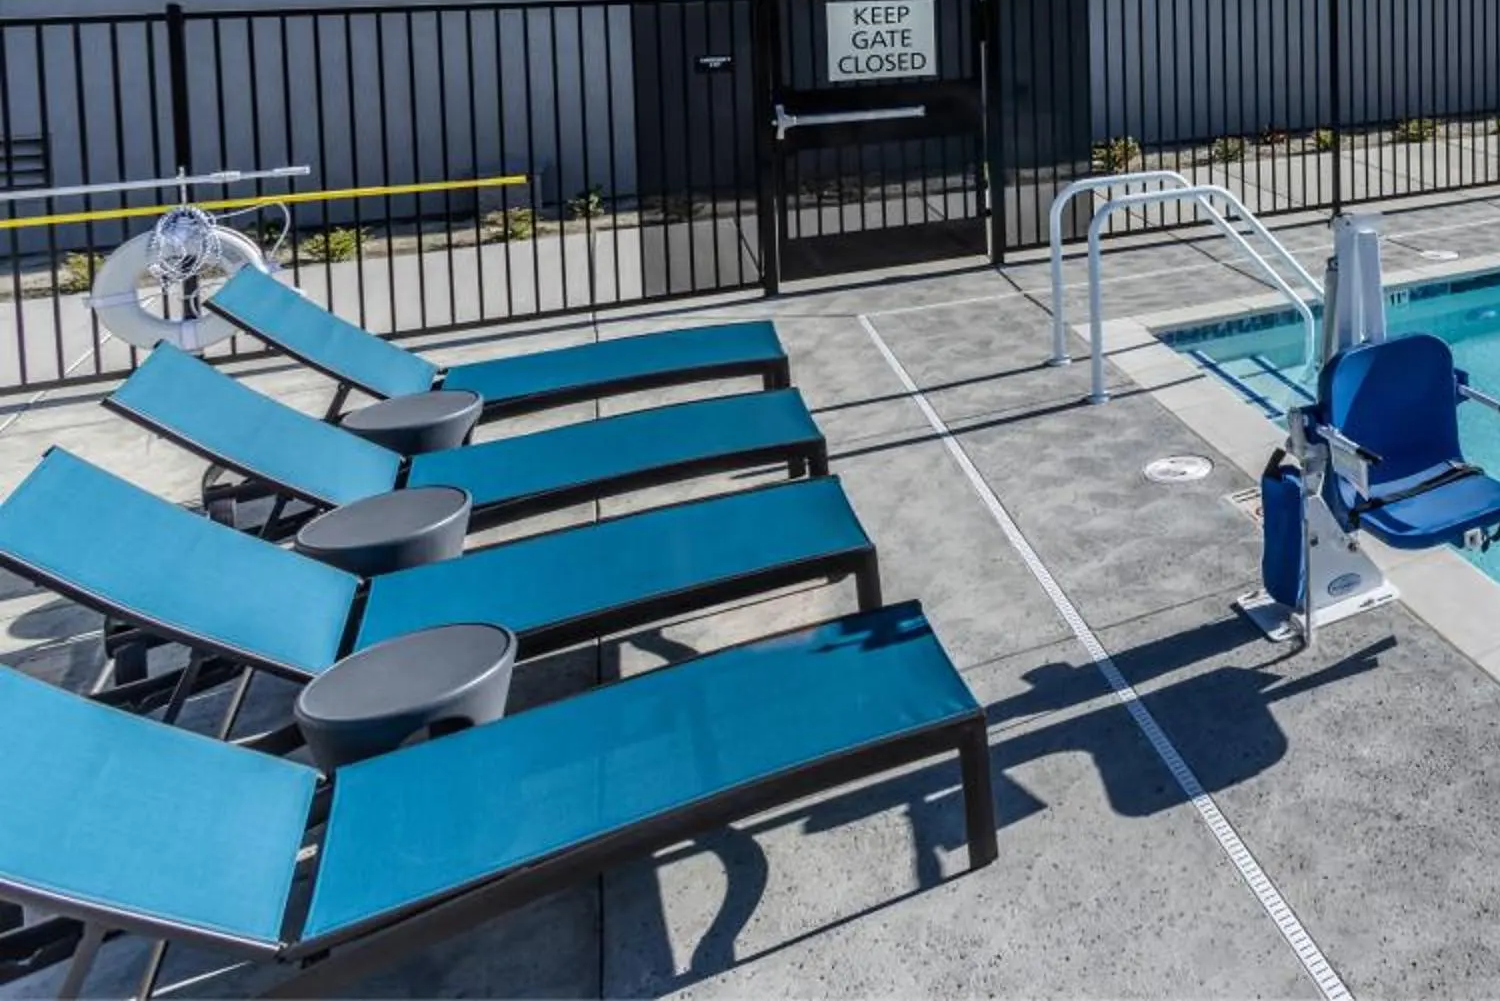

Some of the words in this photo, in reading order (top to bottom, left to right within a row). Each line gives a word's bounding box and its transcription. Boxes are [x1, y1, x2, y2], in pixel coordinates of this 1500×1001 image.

[853, 6, 910, 25] KEEP
[851, 29, 912, 49] GATE
[838, 52, 927, 74] CLOSED
